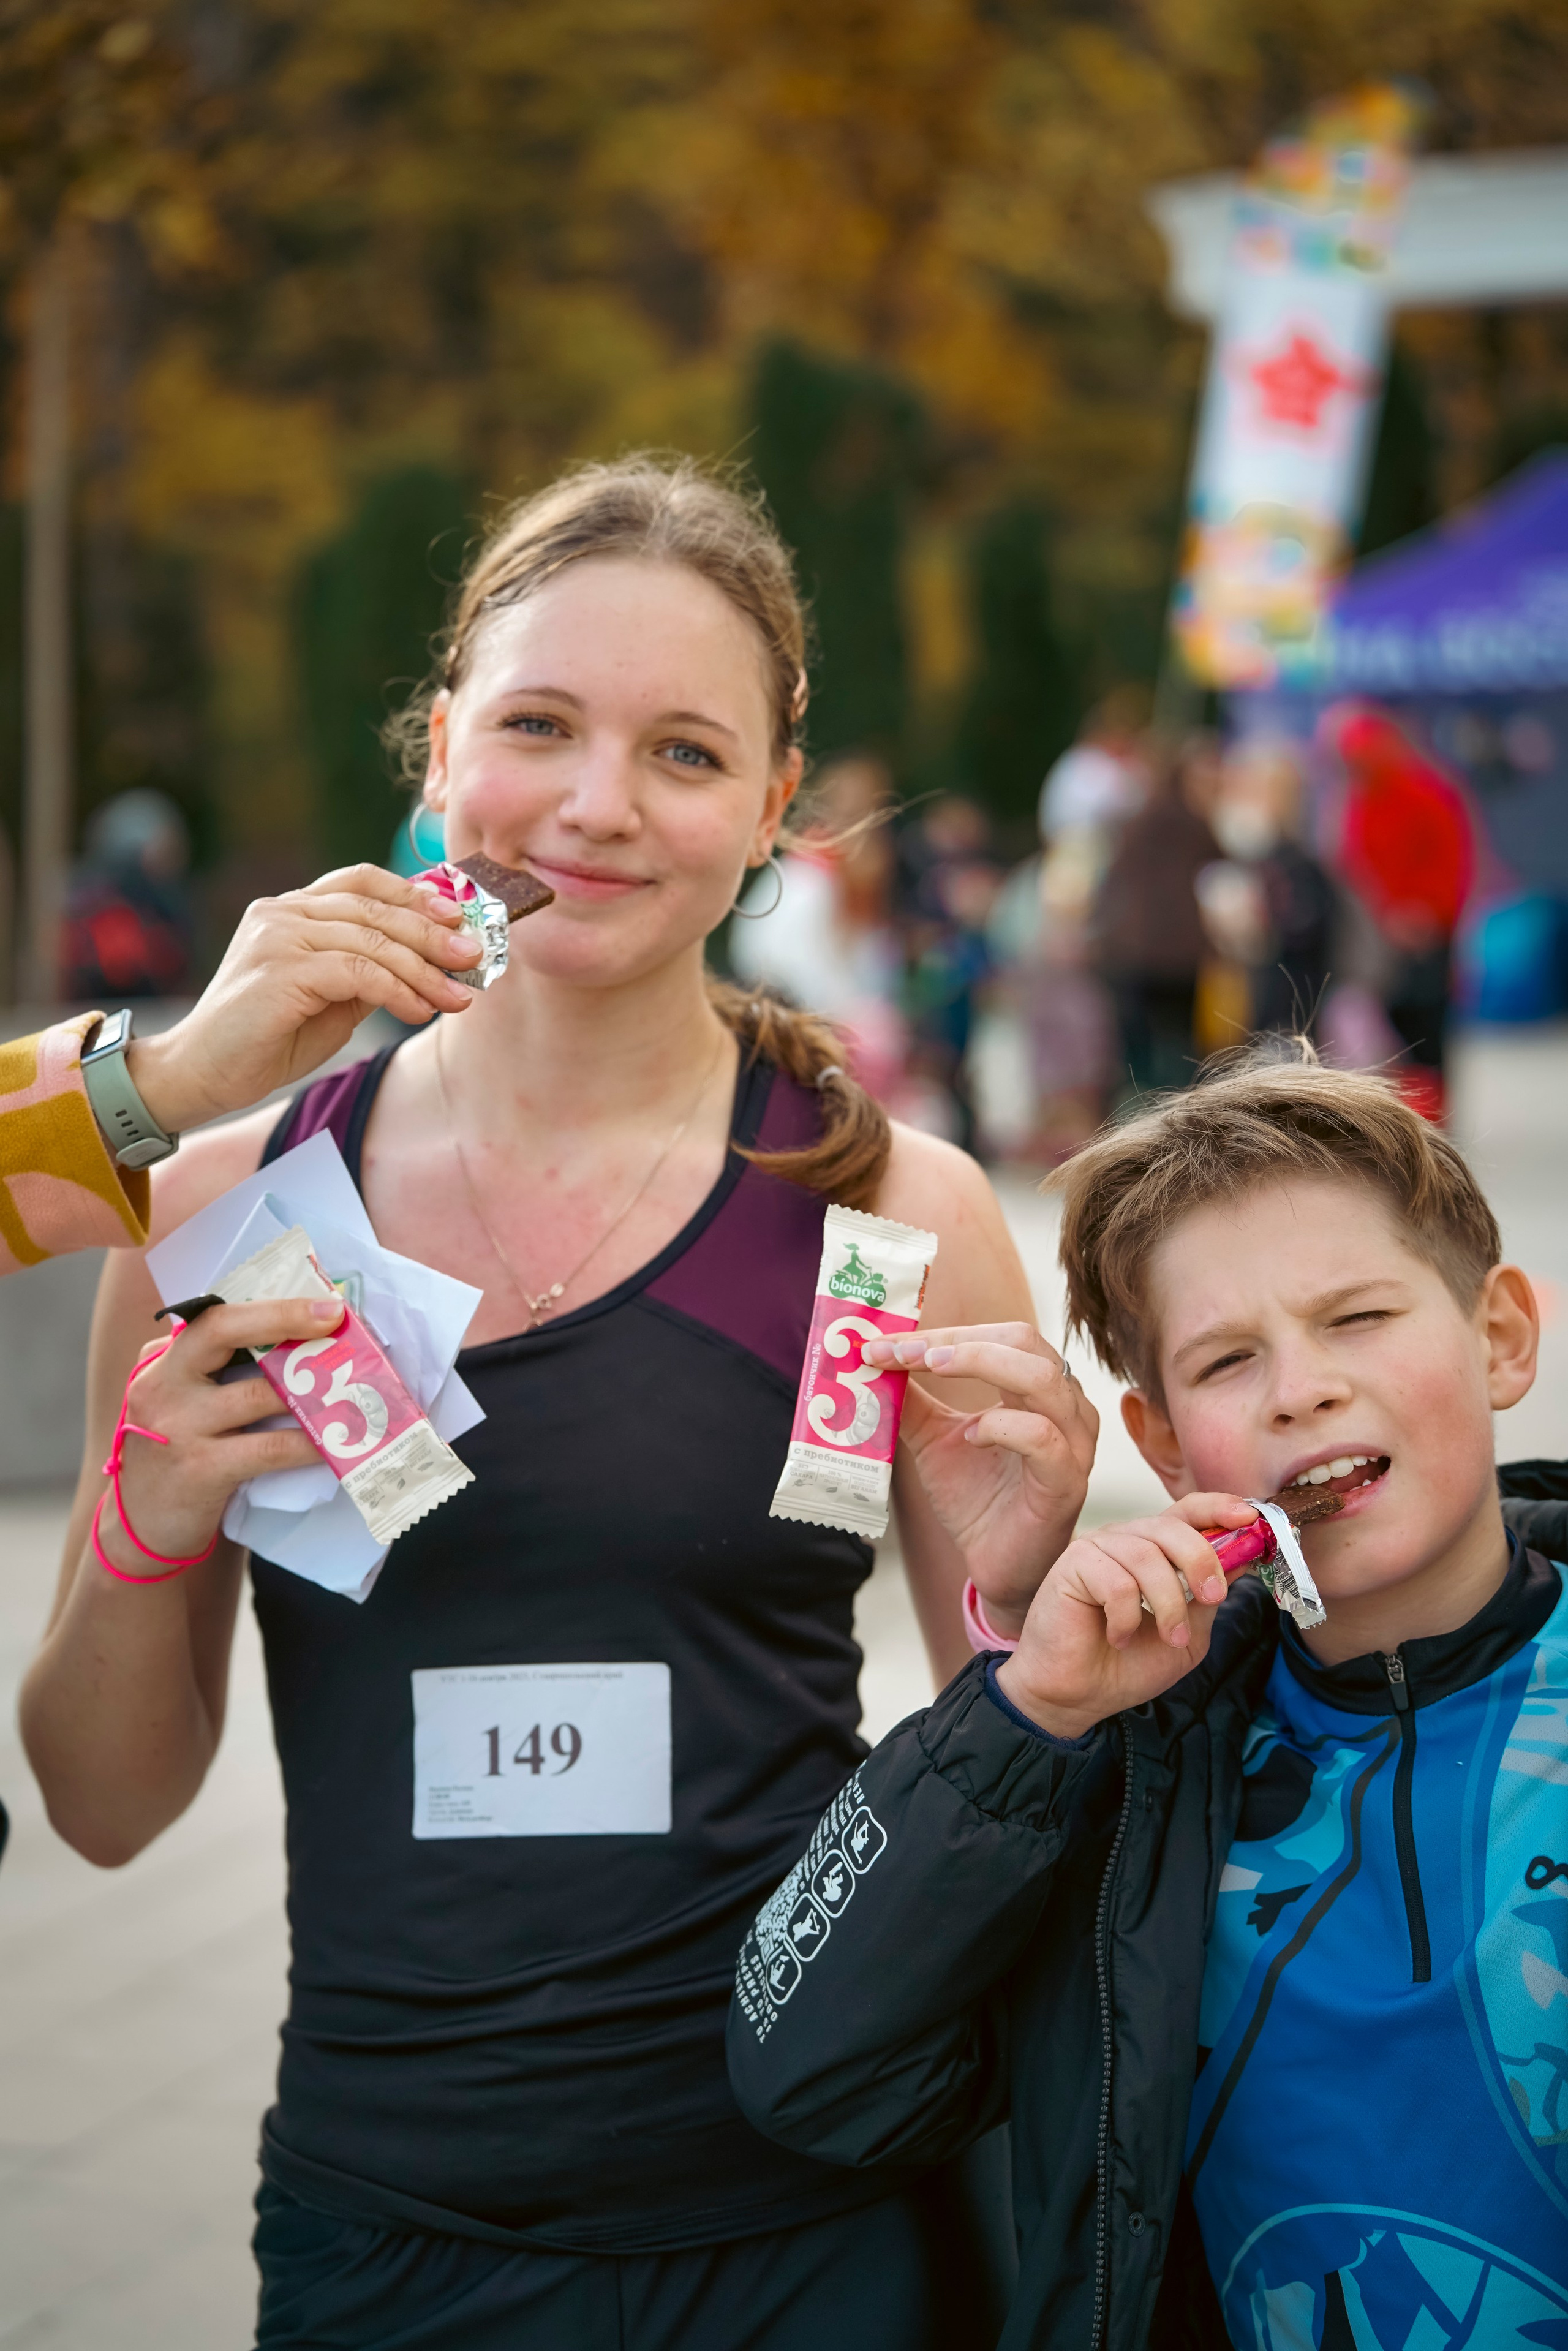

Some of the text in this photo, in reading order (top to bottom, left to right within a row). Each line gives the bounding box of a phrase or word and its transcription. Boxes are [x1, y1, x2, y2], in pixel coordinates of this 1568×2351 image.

[831, 1276, 885, 1302] bionova
[283, 1337, 388, 1459] 3
[804, 1357, 820, 1402] батончик
[807, 1316, 885, 1446] 3
[295, 1406, 322, 1446] батончик
[353, 1432, 418, 1483] пребиотиком
[804, 1450, 879, 1473] пребиотиком
[482, 1722, 582, 1776] 149
[750, 1955, 778, 2022] OBSTACLES
